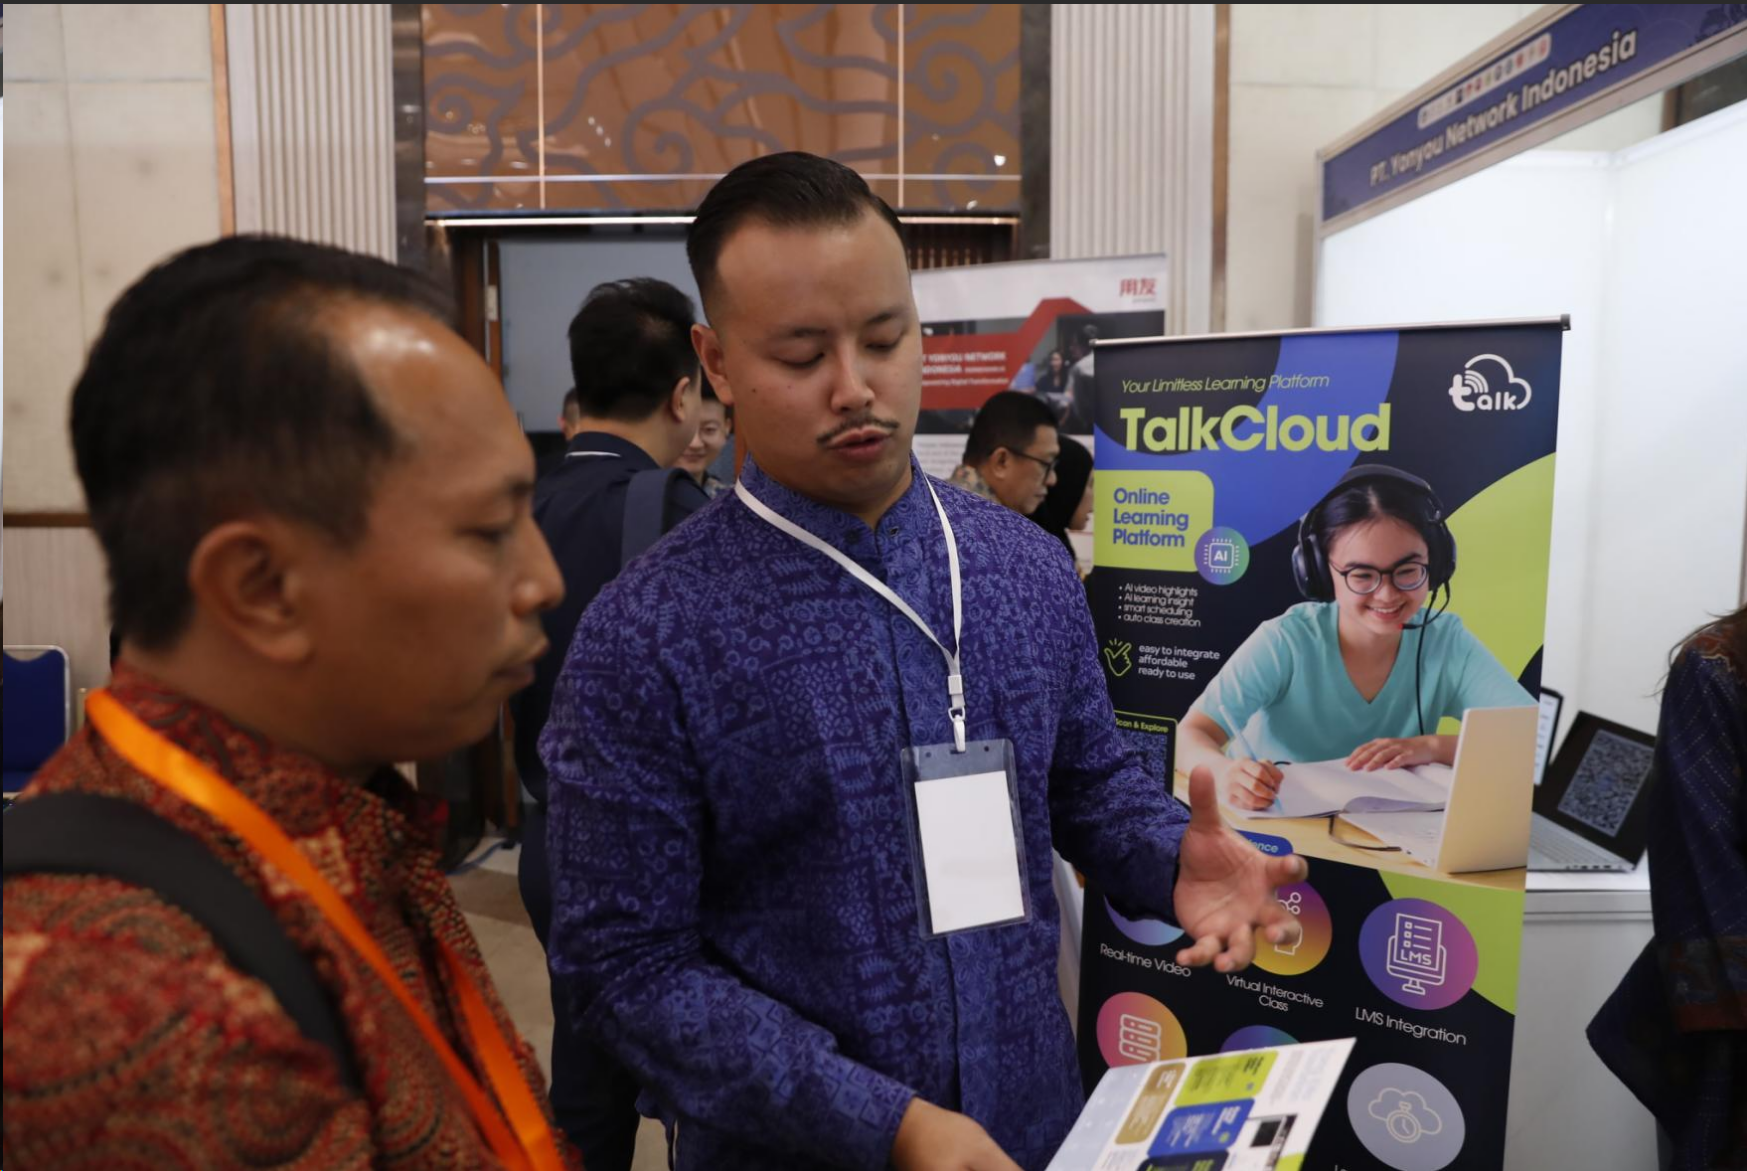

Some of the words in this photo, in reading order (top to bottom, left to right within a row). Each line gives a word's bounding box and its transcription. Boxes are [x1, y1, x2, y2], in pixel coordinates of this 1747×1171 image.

[1446, 92, 1518, 149] Network
[1522, 30, 1637, 112] Indonesia
[1122, 379, 1151, 394] Your
[1152, 377, 1203, 393] Limitless
[1205, 375, 1267, 393] Learning
[1269, 373, 1330, 389] Platform
[1448, 373, 1517, 411] talk
[1120, 403, 1391, 452] TalkCloud
[1113, 487, 1170, 505] Online
[1113, 508, 1190, 531] Learning
[1113, 528, 1186, 547] Platform
[1213, 550, 1228, 562] AI
[1134, 583, 1157, 594] video
[1159, 584, 1198, 597] highlights
[1133, 594, 1167, 606] learning
[1167, 596, 1195, 608] insight
[1123, 603, 1145, 612] smart
[1147, 605, 1193, 619] scheduling
[1123, 613, 1142, 622] auto
[1144, 614, 1164, 624] class
[1164, 617, 1201, 627] creation
[1138, 655, 1188, 668] affordable
[1139, 645, 1160, 656] easy
[1162, 646, 1172, 655] to
[1174, 645, 1220, 660] integrate
[1138, 666, 1164, 679] ready
[1166, 669, 1176, 678] to
[1178, 671, 1196, 680] use
[1133, 720, 1140, 729] &
[1140, 721, 1169, 733] Explore
[1100, 943, 1152, 968] Real-time
[1153, 957, 1191, 977] Video
[1400, 949, 1432, 966] LMS
[1226, 974, 1261, 993] Virtual
[1262, 982, 1324, 1008] Interactive
[1258, 994, 1289, 1012] Class
[1355, 1006, 1385, 1026] LMS
[1386, 1014, 1467, 1046] Integration
